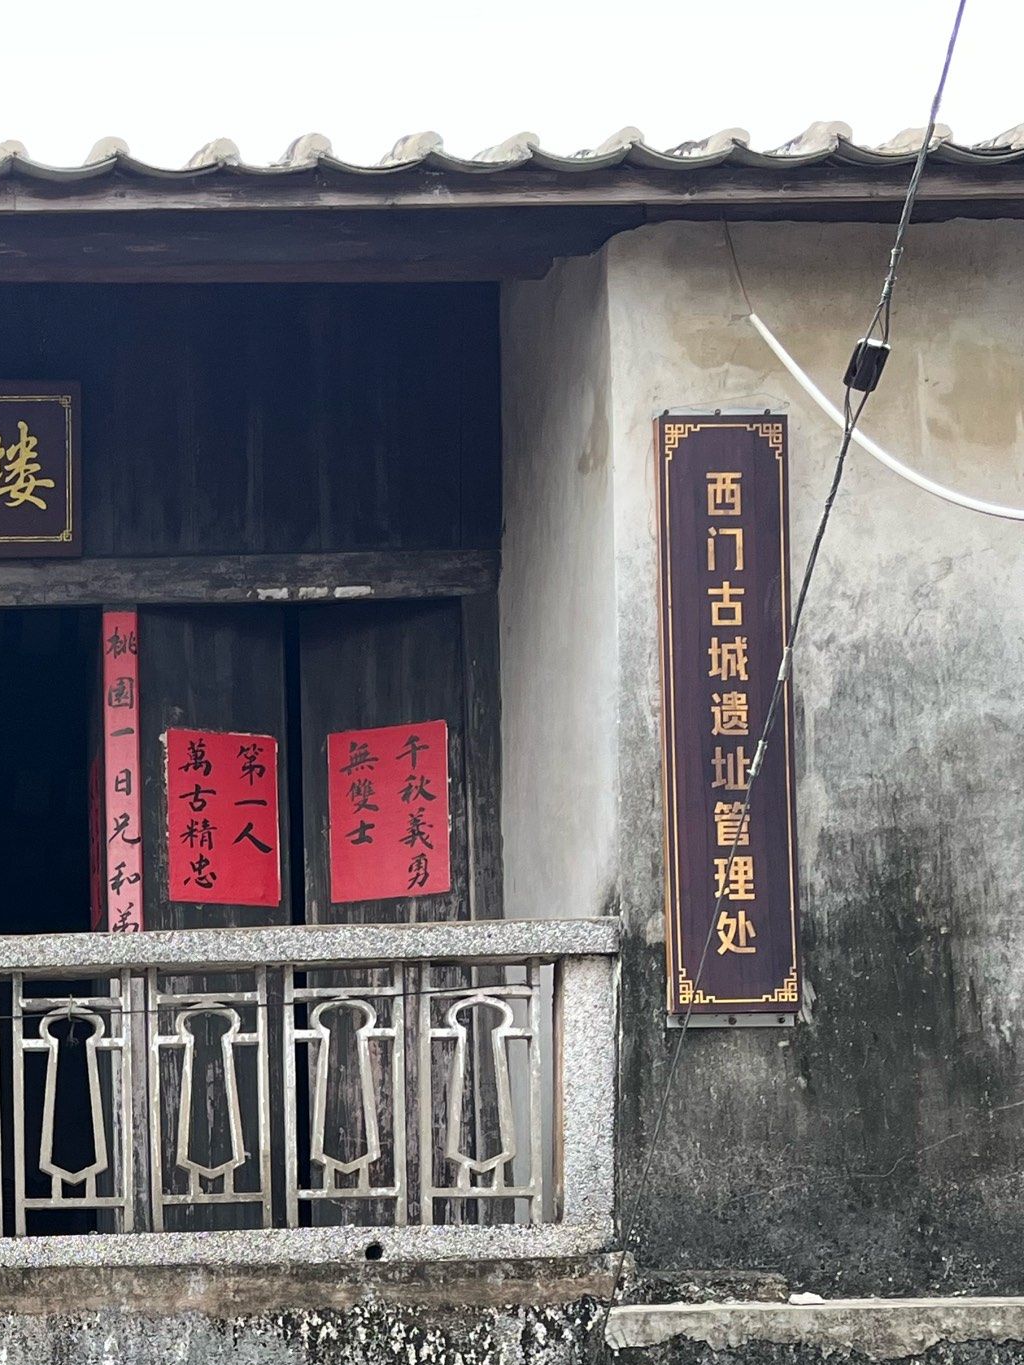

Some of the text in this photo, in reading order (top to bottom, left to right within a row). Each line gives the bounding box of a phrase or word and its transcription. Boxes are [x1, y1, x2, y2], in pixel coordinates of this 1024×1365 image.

[106, 627, 139, 932] 桃園一日兄和弟
[706, 471, 757, 956] 西门古城遗址管理处
[178, 737, 217, 889] 萬古精忠
[233, 743, 273, 854] 第一人
[339, 741, 380, 845] 無雙士
[396, 735, 437, 890] 千秋義勇
